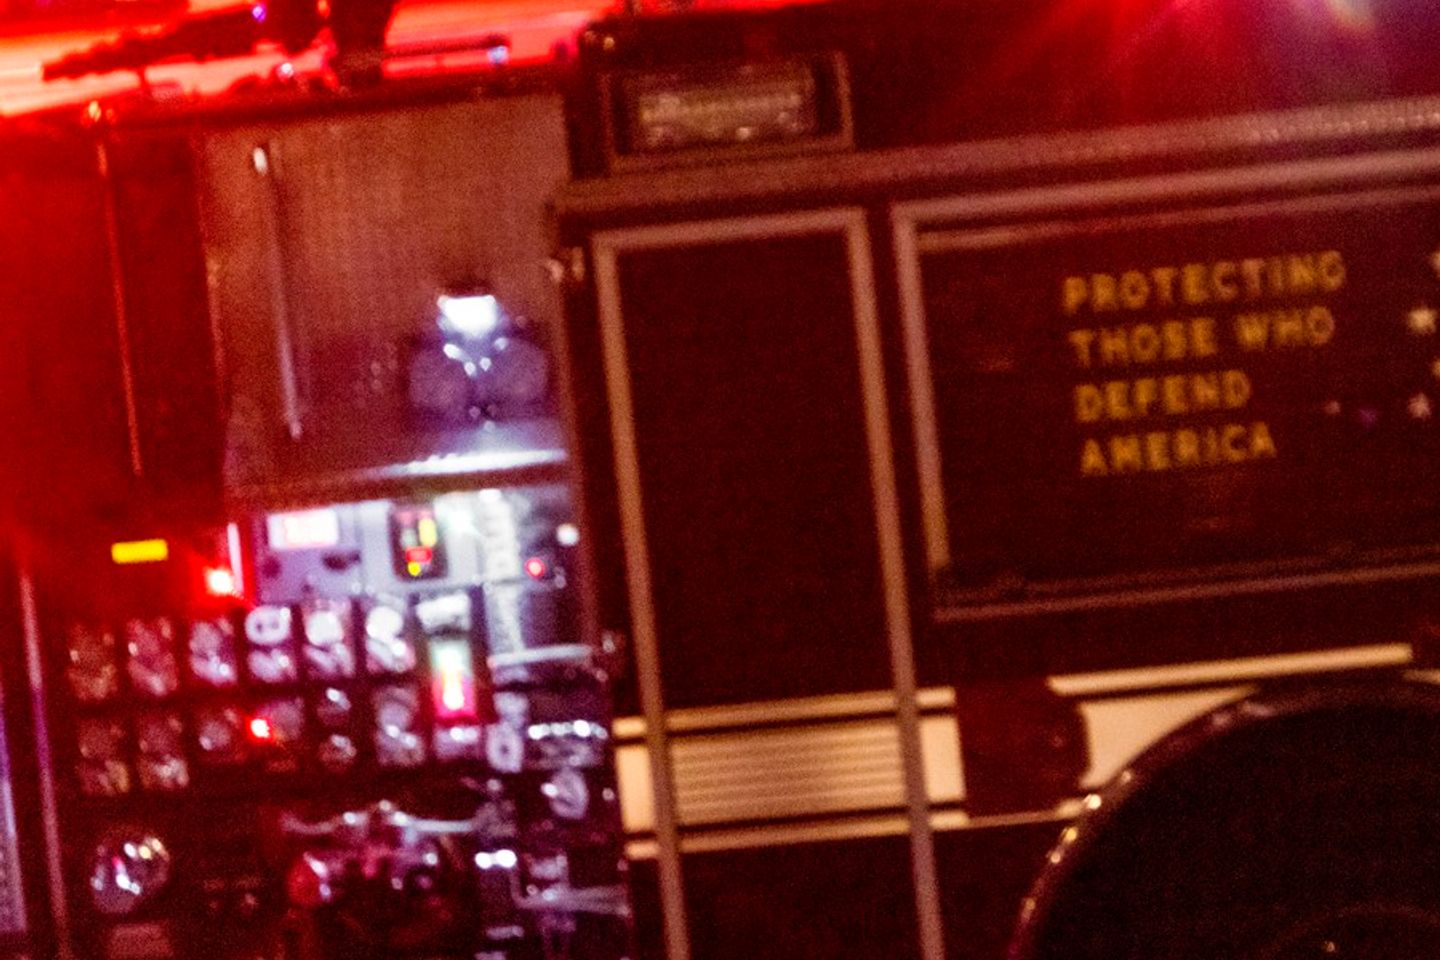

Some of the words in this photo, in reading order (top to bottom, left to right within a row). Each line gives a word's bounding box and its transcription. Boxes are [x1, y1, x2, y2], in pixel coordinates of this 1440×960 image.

[1062, 250, 1347, 315] PROTECTING
[1068, 317, 1218, 369] THOSE
[1234, 305, 1336, 350] WHO
[1074, 369, 1251, 423] DEFEND
[1080, 421, 1277, 476] AMERICA
